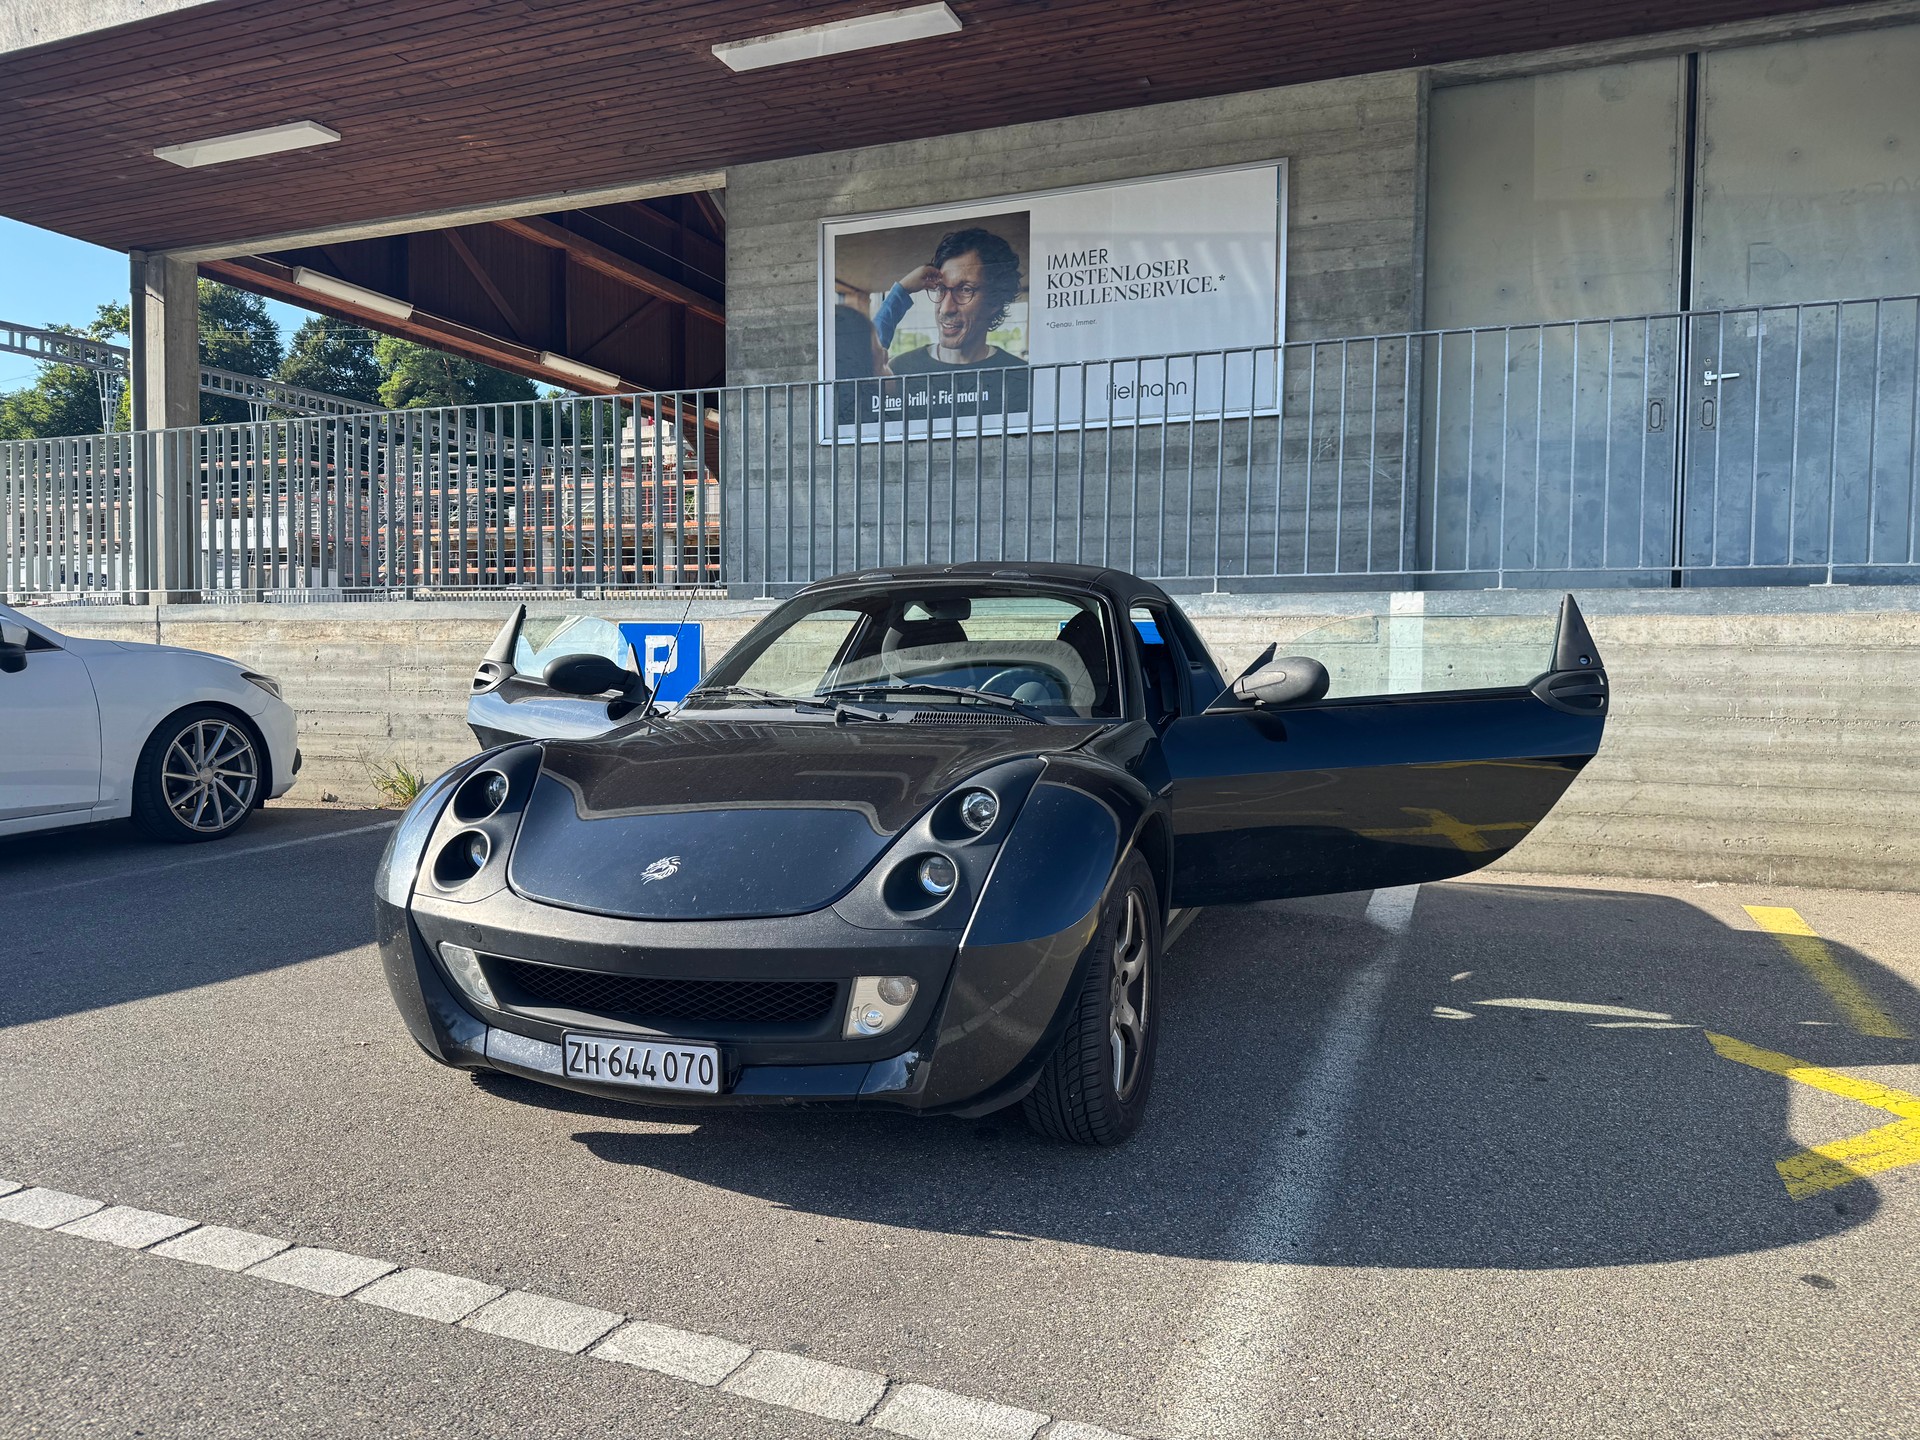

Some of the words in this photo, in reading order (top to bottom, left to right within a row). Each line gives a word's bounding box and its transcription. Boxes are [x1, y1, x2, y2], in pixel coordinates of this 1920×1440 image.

[1047, 249, 1108, 270] IMMER
[1047, 258, 1190, 289] KOSTENLOSER
[872, 395, 902, 410] Dine
[645, 635, 678, 693] P
[663, 1051, 714, 1086] 070
